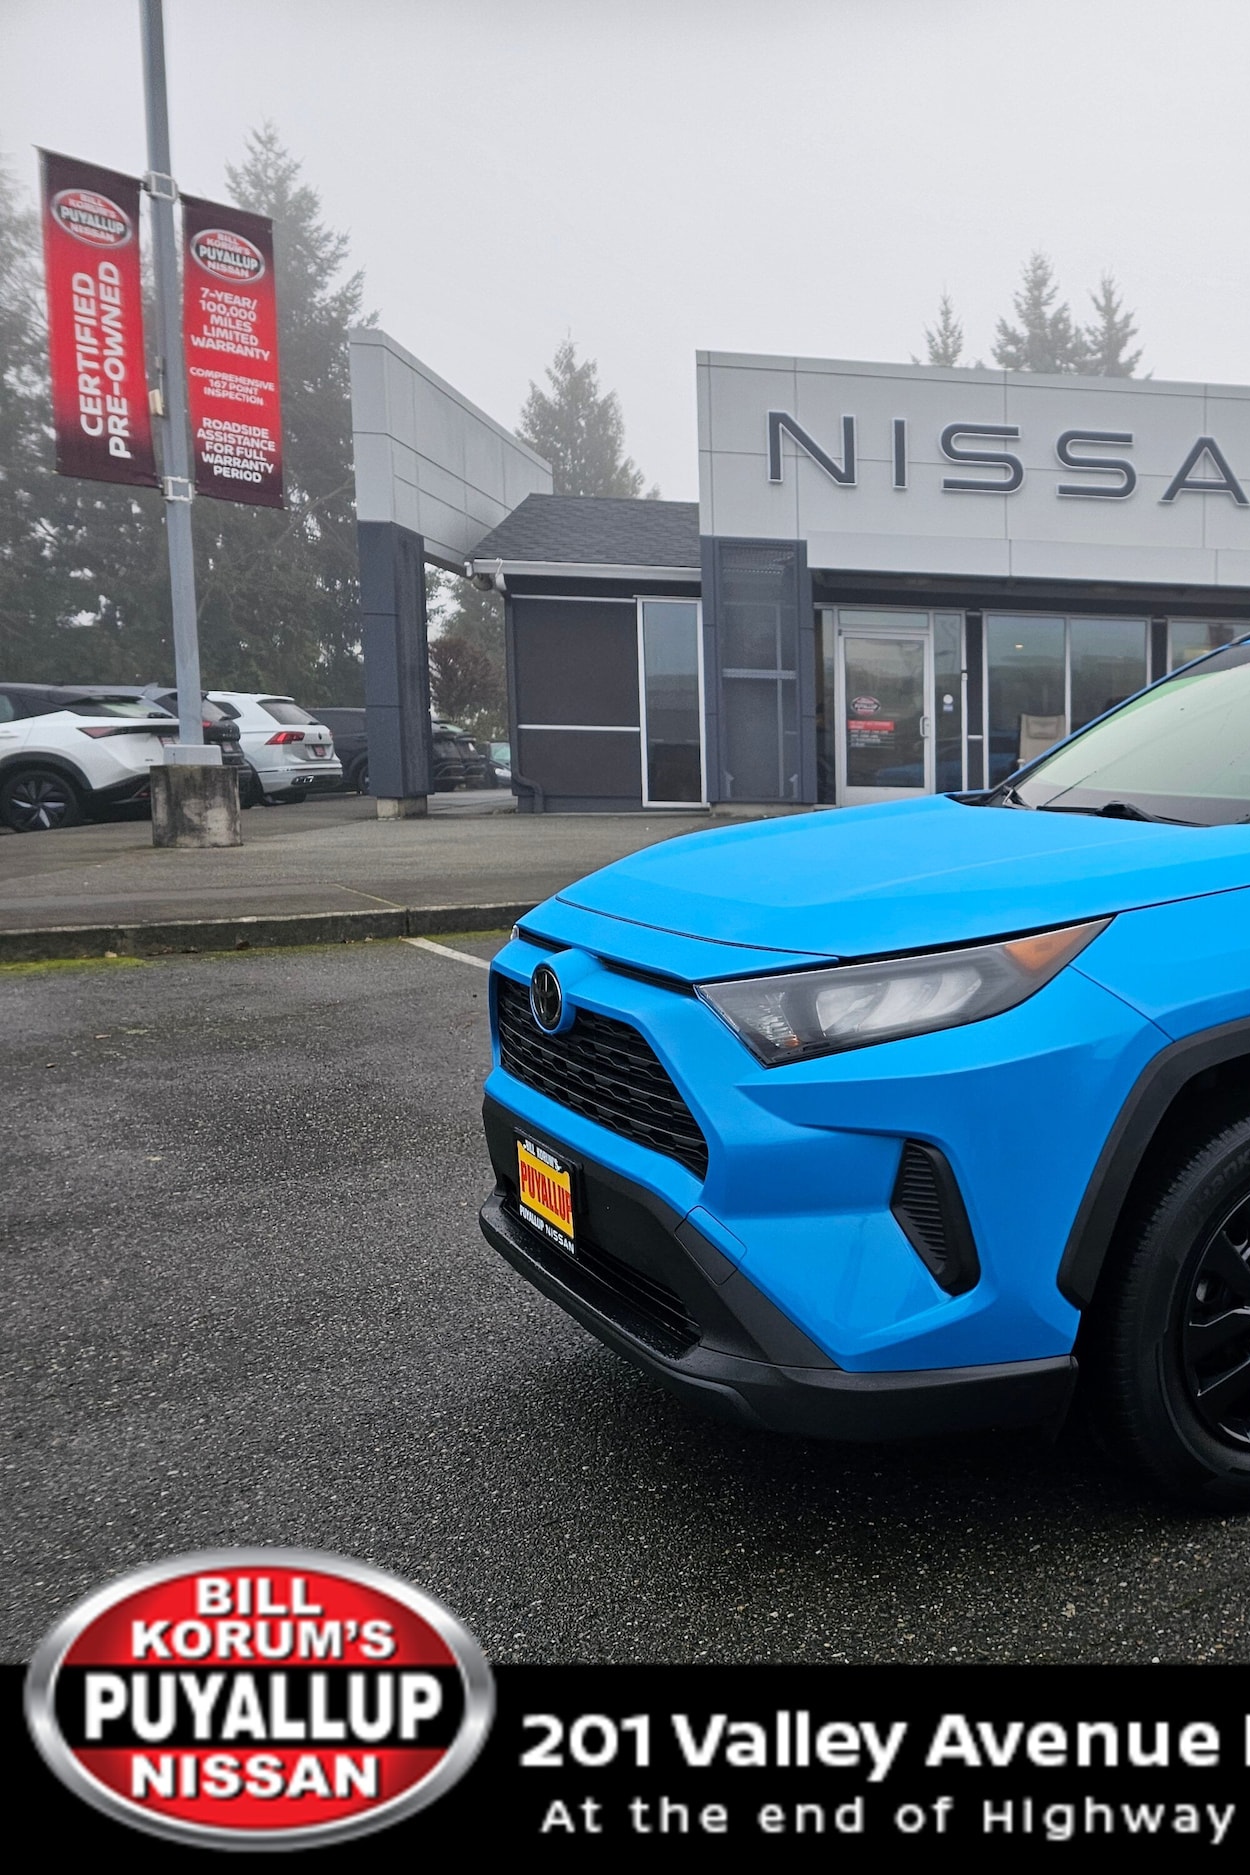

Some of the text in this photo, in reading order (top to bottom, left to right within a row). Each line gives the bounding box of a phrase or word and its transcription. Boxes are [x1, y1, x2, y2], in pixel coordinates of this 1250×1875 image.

[60, 205, 125, 235] PUYALLUP
[199, 244, 259, 271] PUYALLUP
[207, 260, 250, 278] NISSAN
[200, 286, 258, 310] 7-YEAR/
[210, 314, 253, 333] MILES
[190, 335, 271, 361] WARRANTY
[203, 325, 259, 347] LIMITED
[72, 272, 104, 437] CERTIFIED
[98, 261, 132, 459] PRE-OWNED
[189, 366, 275, 392] COMPREHENSIVE
[229, 382, 259, 396] POINT
[203, 386, 264, 406] INSPECTION
[197, 428, 276, 452] ASSISTANCE
[202, 417, 270, 439] ROADSIDE
[201, 451, 274, 474] WARRANTY
[205, 441, 267, 462] FOR FULL
[213, 465, 262, 483] PERIOD
[520, 1160, 572, 1225] PUYALLUP
[519, 1203, 575, 1255] PUYALLUP NISSAN
